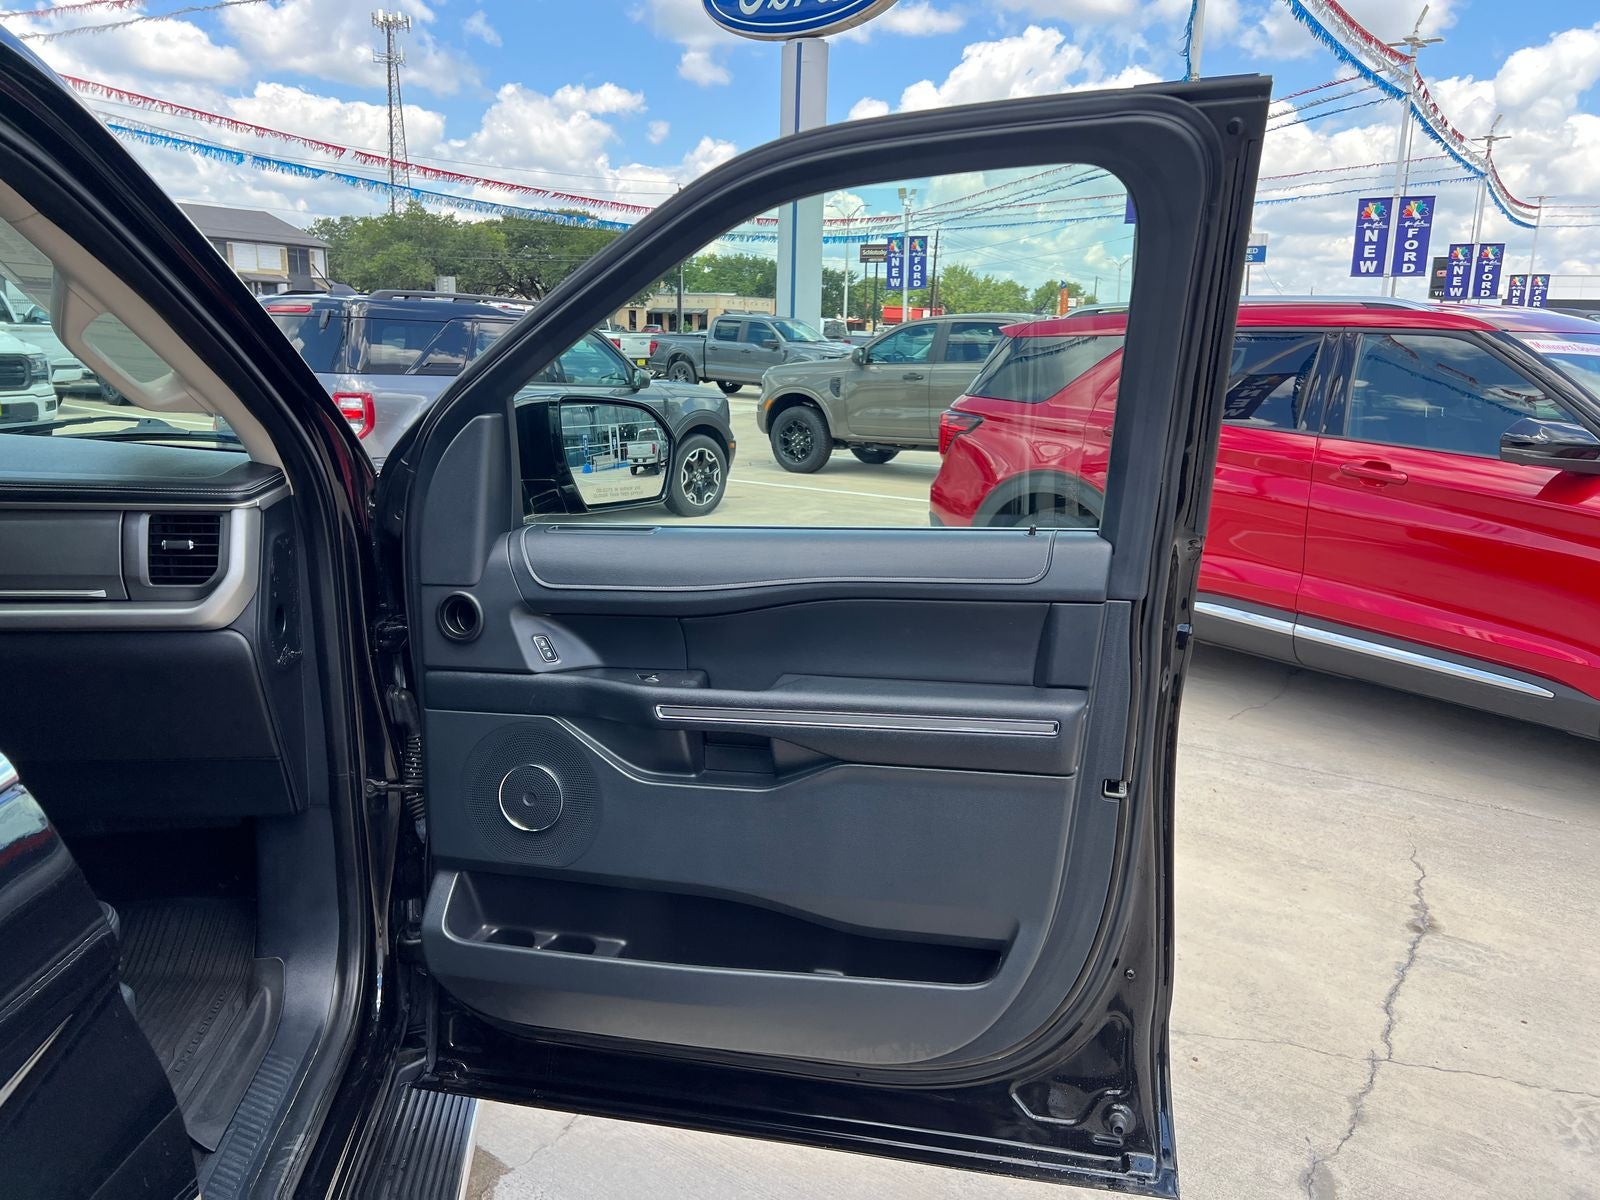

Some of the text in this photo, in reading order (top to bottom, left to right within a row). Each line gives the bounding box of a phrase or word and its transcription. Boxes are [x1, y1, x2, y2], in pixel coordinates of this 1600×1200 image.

[1359, 229, 1379, 273] NEW
[1402, 228, 1419, 273] FORD
[890, 257, 901, 287] NEW
[912, 256, 922, 287] FORD
[1449, 265, 1464, 297] NEW
[1480, 265, 1494, 297] FORD
[1511, 289, 1521, 305] NE
[1532, 289, 1542, 307] FOR
